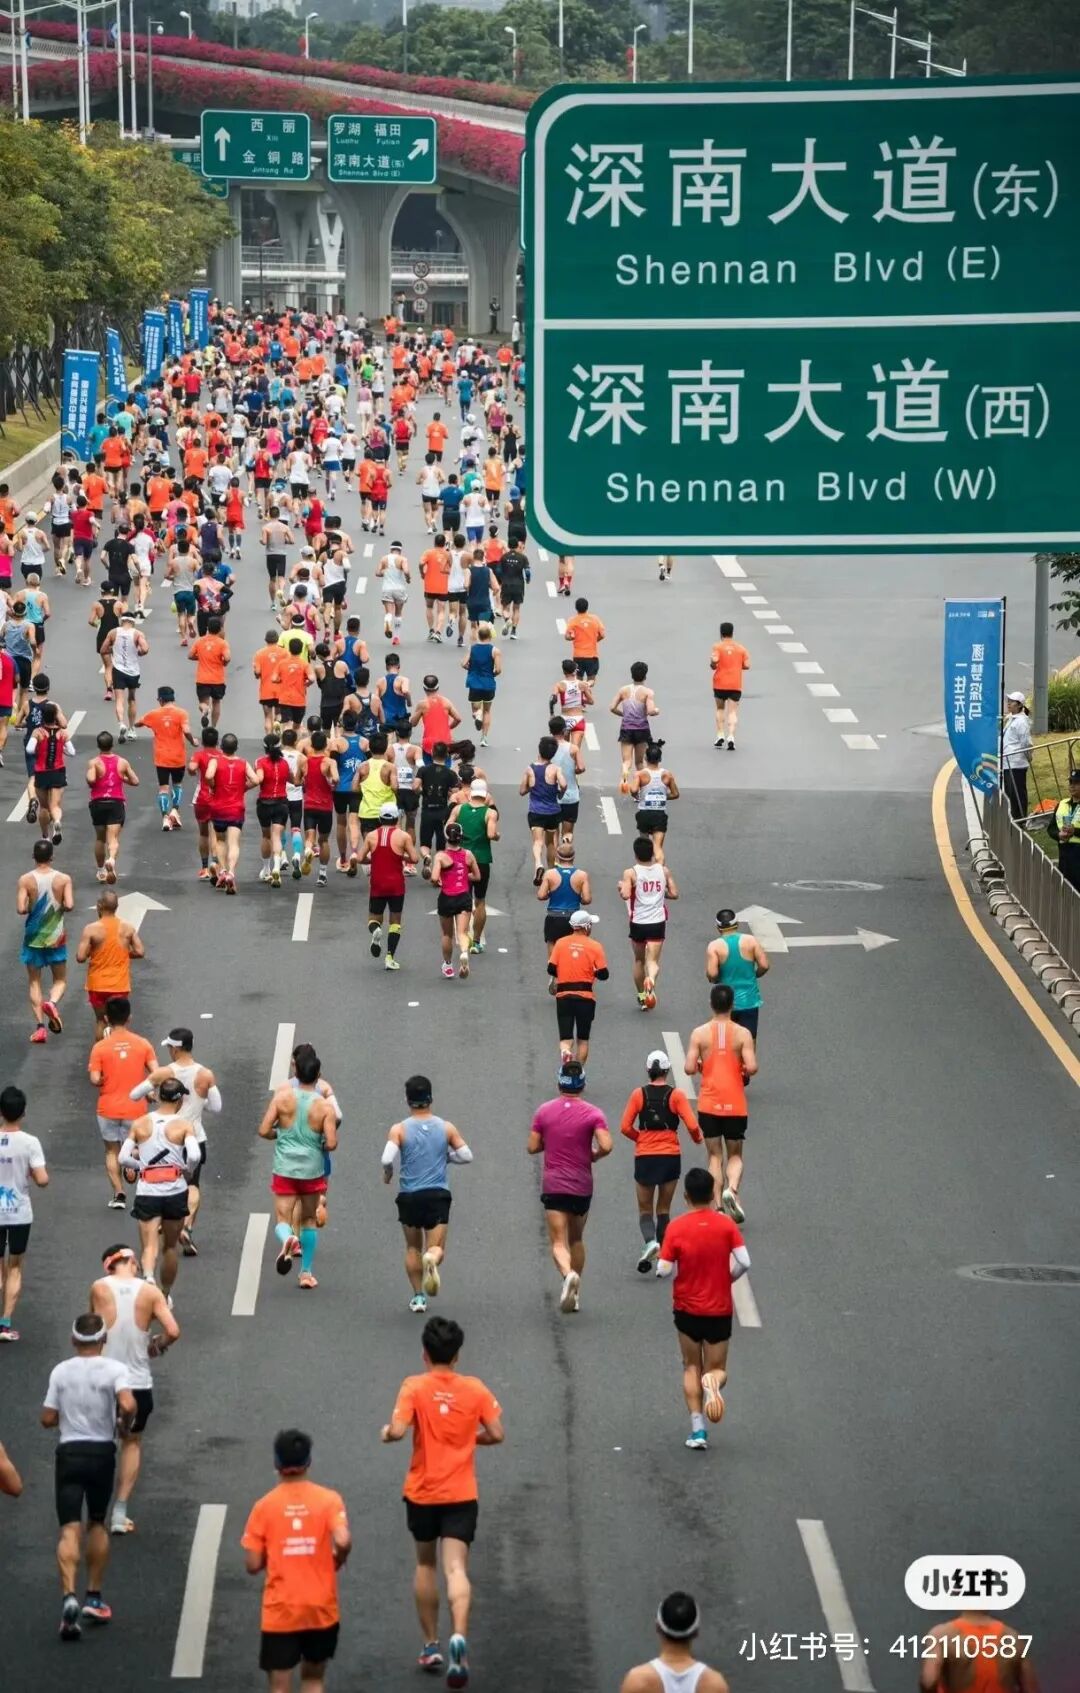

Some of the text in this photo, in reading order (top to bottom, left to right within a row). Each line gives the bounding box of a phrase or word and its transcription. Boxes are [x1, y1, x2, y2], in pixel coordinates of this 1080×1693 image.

[251, 118, 296, 134] 西丽
[333, 122, 401, 137] 罗湖 福田
[242, 150, 304, 165] 金铜路
[565, 135, 1058, 227] 深南大道(东)
[616, 246, 1000, 285] Shennan Blvd (E)
[566, 358, 1049, 444] 深南大道(西)
[606, 466, 996, 503] Shennan Blvd (W)
[643, 881, 661, 892] 075
